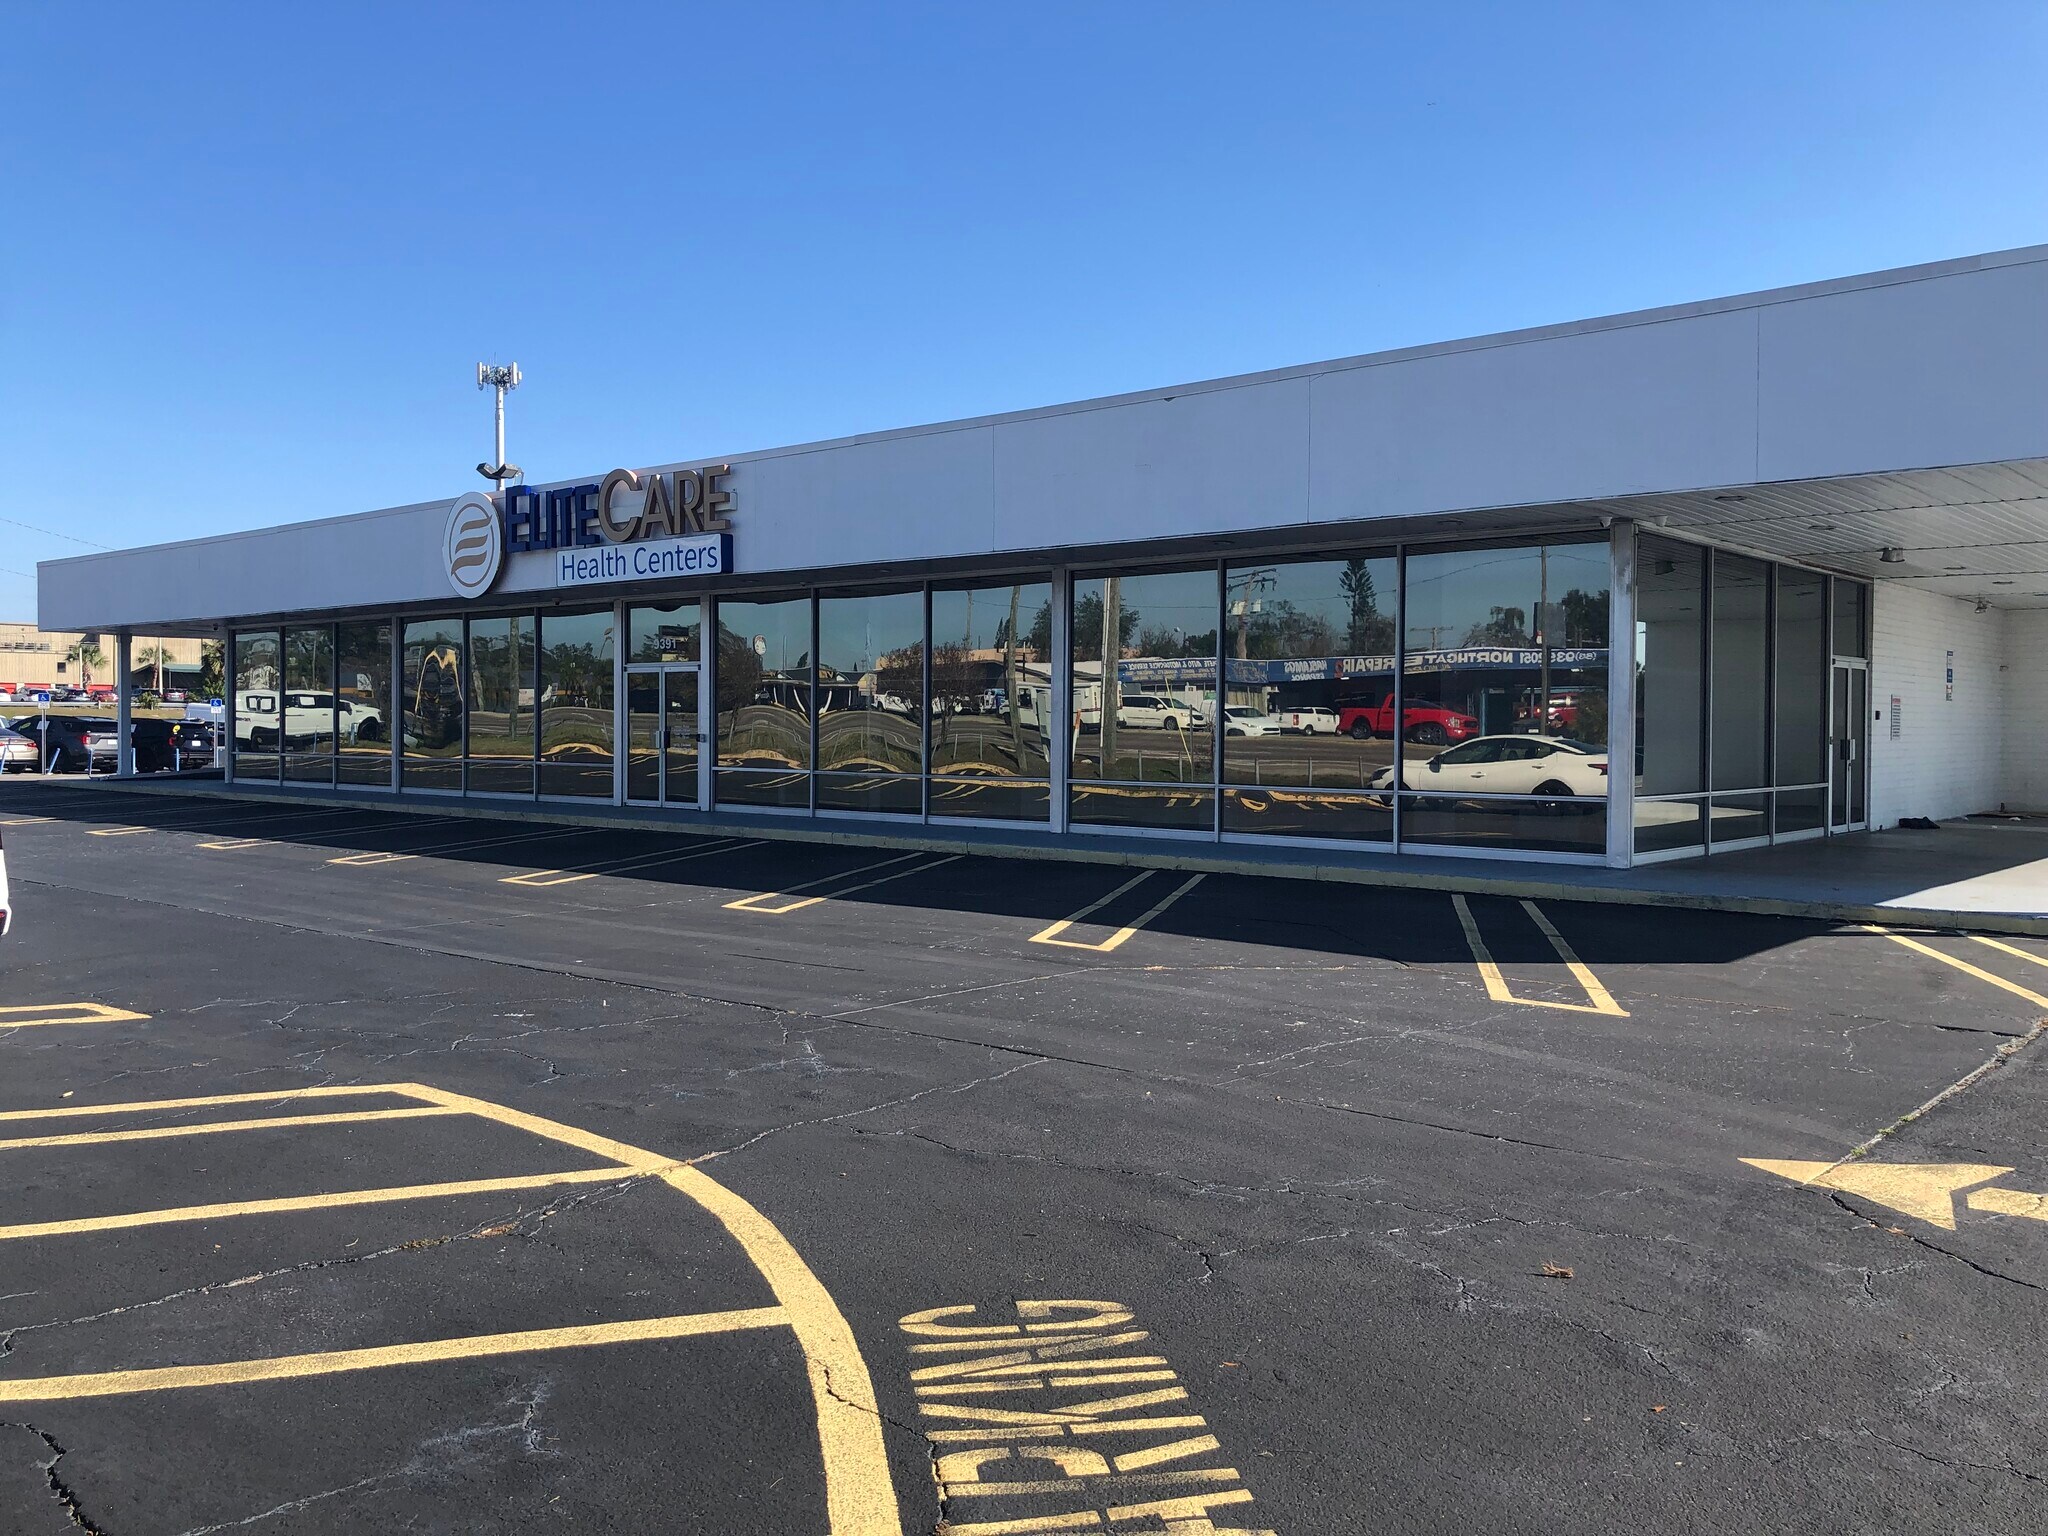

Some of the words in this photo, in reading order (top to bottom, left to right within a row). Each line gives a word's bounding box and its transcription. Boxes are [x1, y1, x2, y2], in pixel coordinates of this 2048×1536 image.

[562, 550, 627, 581] Health
[633, 545, 718, 575] Centers
[654, 638, 677, 650] 9391
